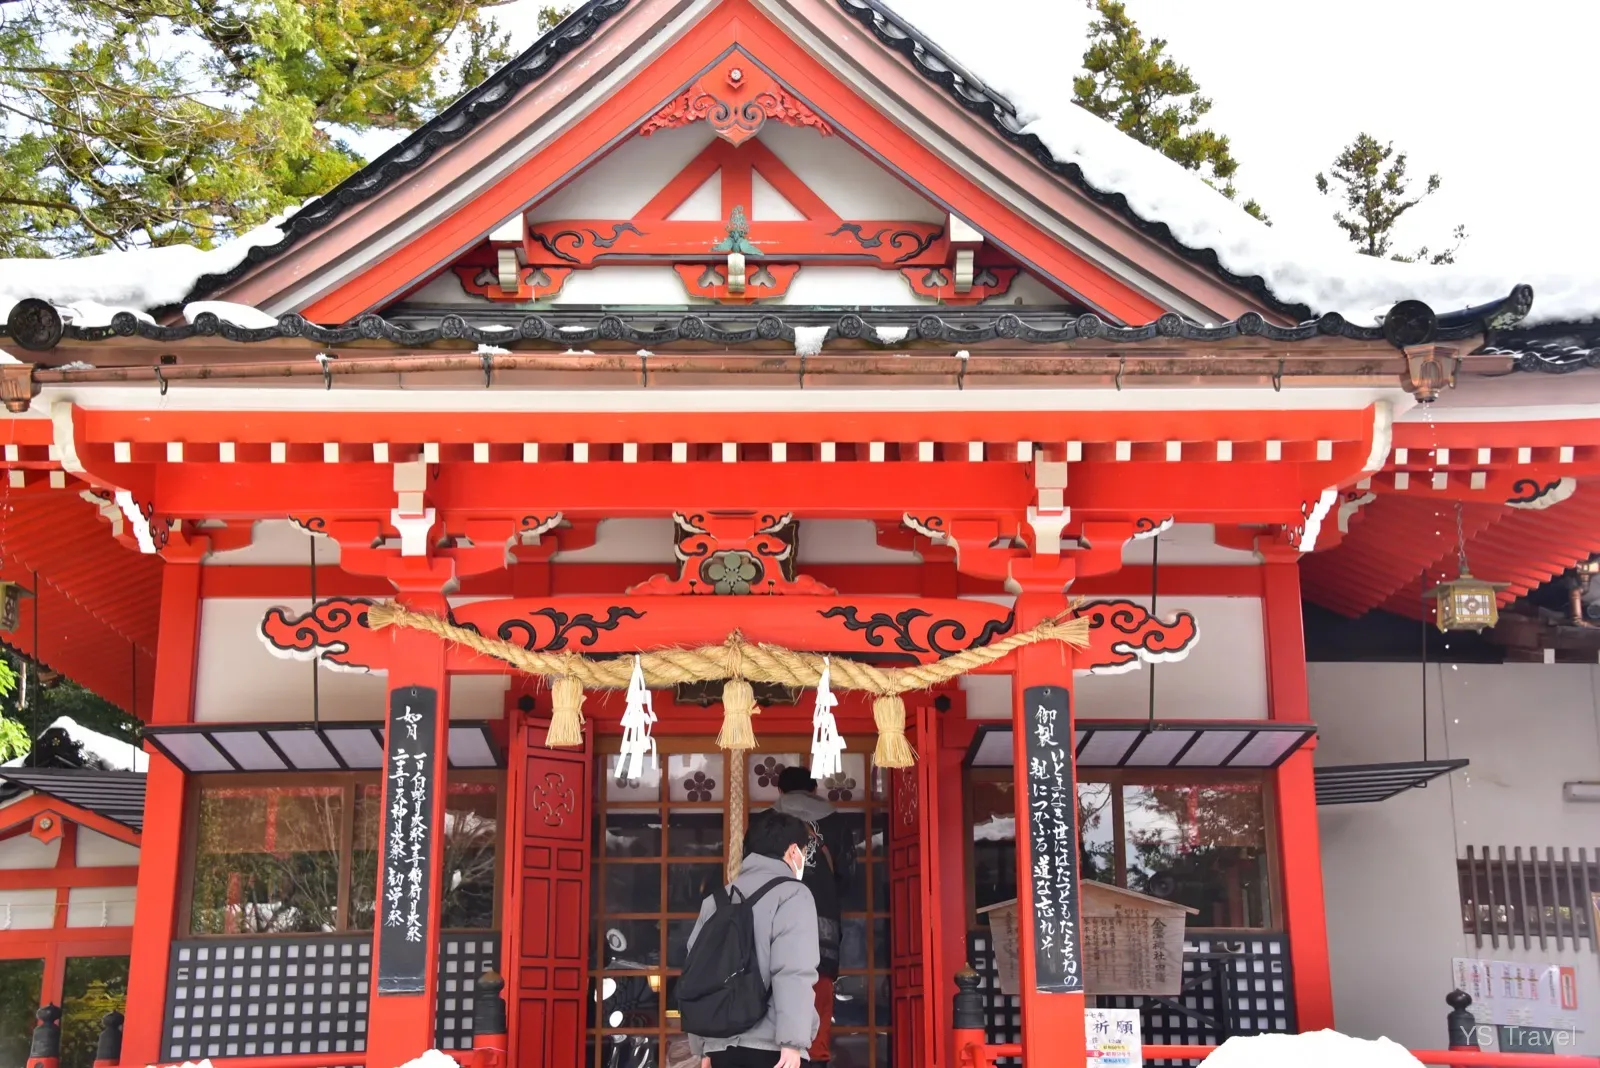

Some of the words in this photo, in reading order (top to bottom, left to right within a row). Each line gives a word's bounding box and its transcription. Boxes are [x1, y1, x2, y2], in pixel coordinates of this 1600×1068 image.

[395, 705, 423, 741] 如月
[1034, 704, 1059, 747] 御製
[1092, 1019, 1134, 1035] 祈願
